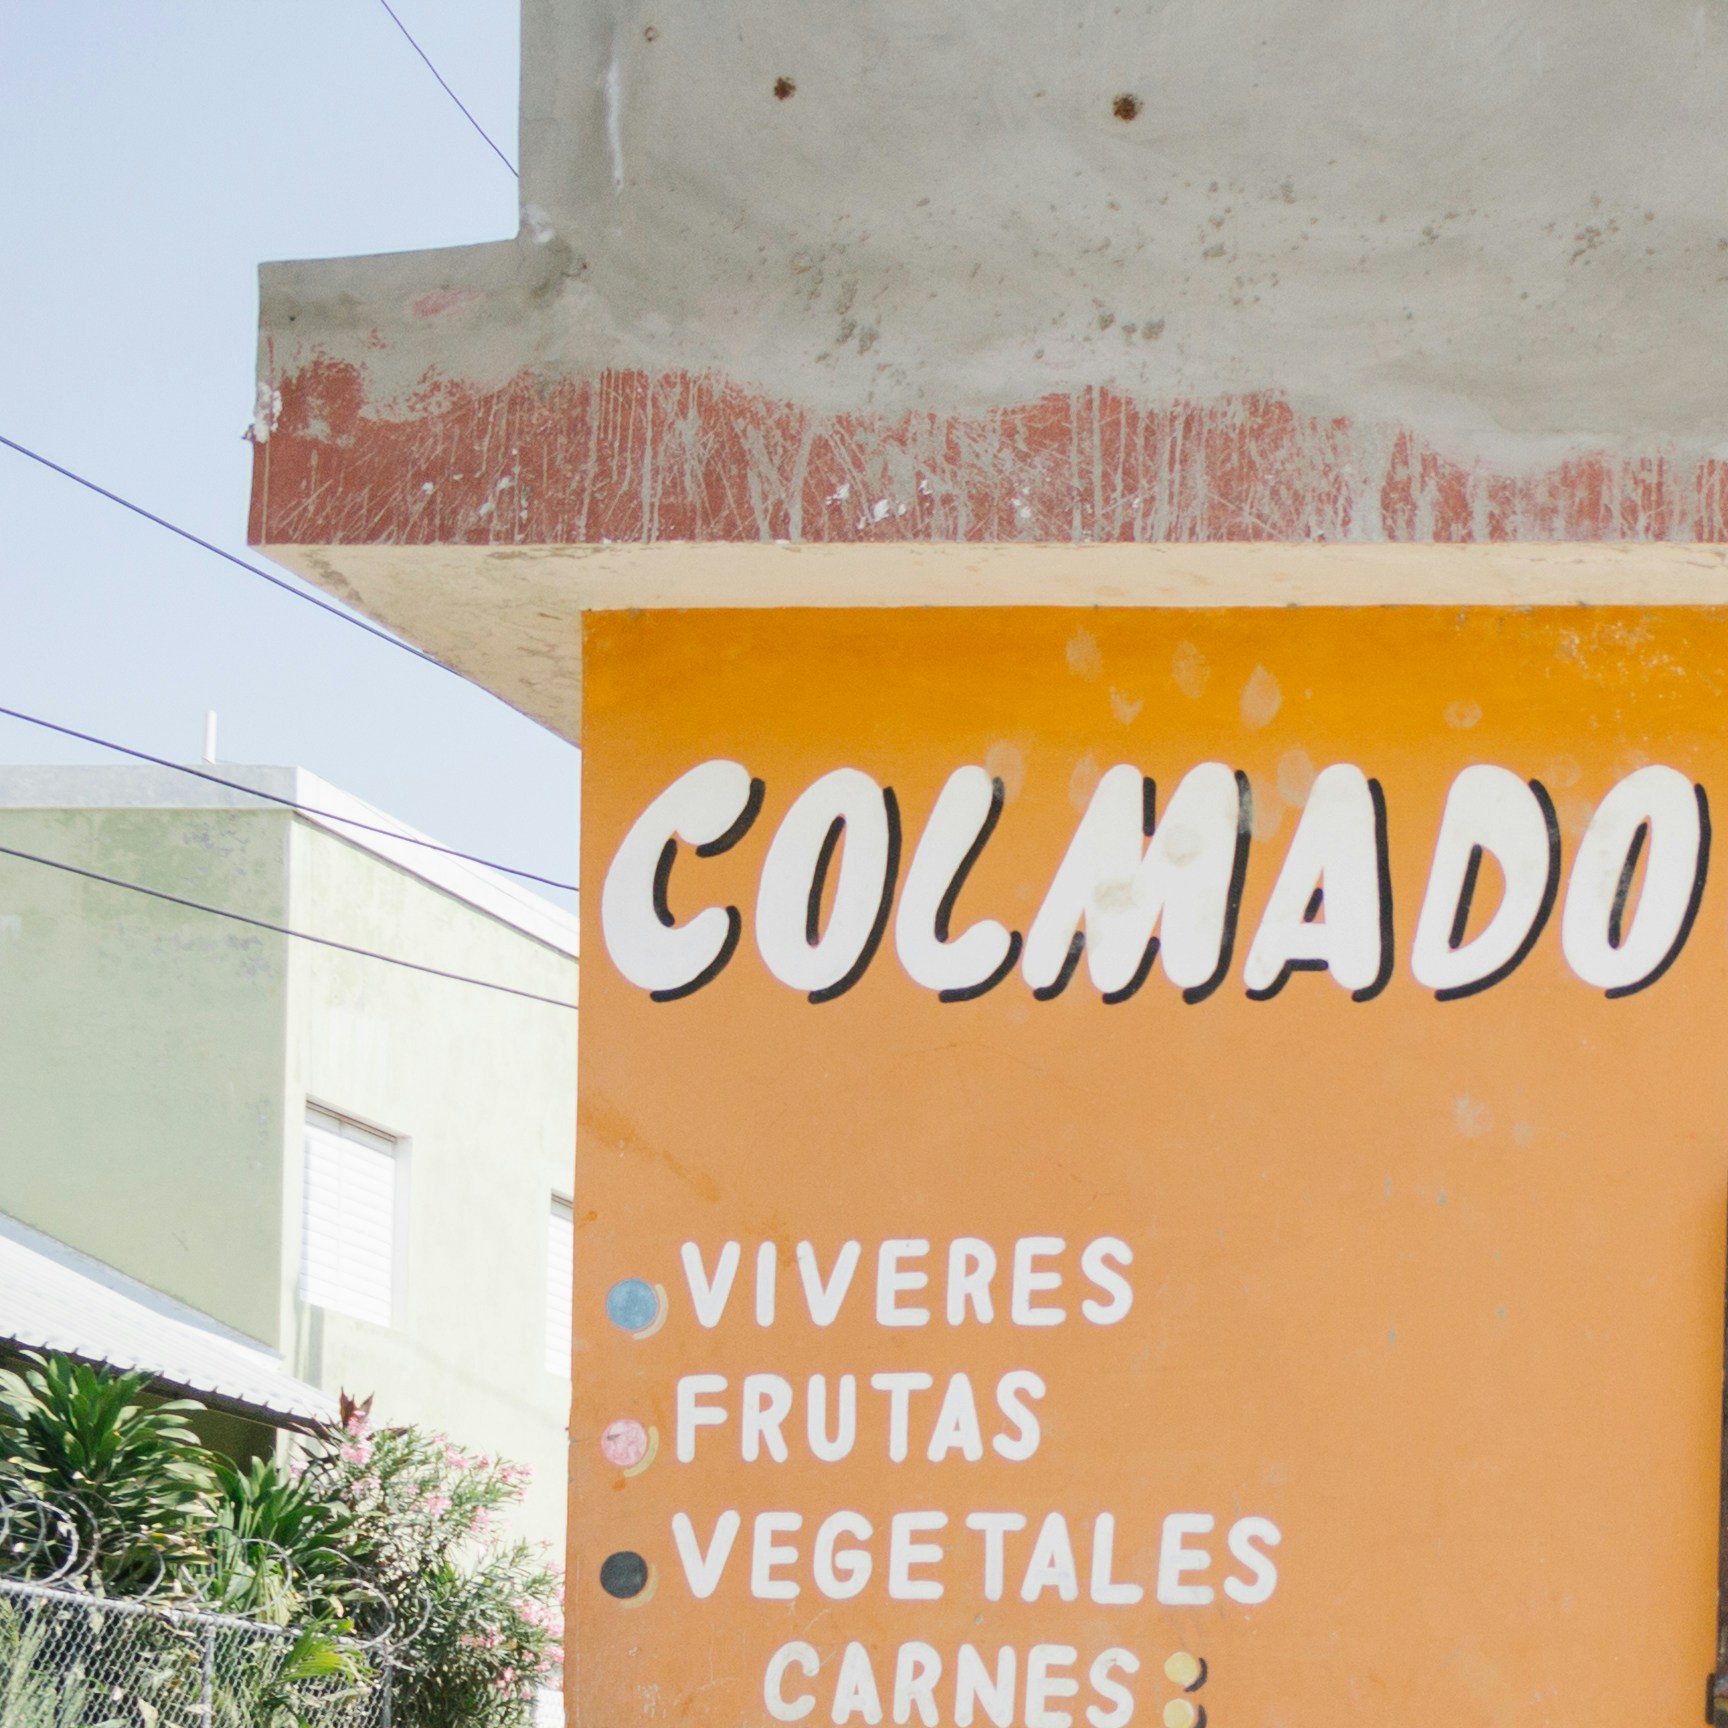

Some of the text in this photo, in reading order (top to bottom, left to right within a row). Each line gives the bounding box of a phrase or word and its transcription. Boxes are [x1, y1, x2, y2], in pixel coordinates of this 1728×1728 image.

[602, 760, 1707, 1003] COLMADO
[680, 1236, 1134, 1329] VIVERES
[676, 1370, 1047, 1463] FRUTAS
[671, 1509, 1282, 1606] VEGETALES
